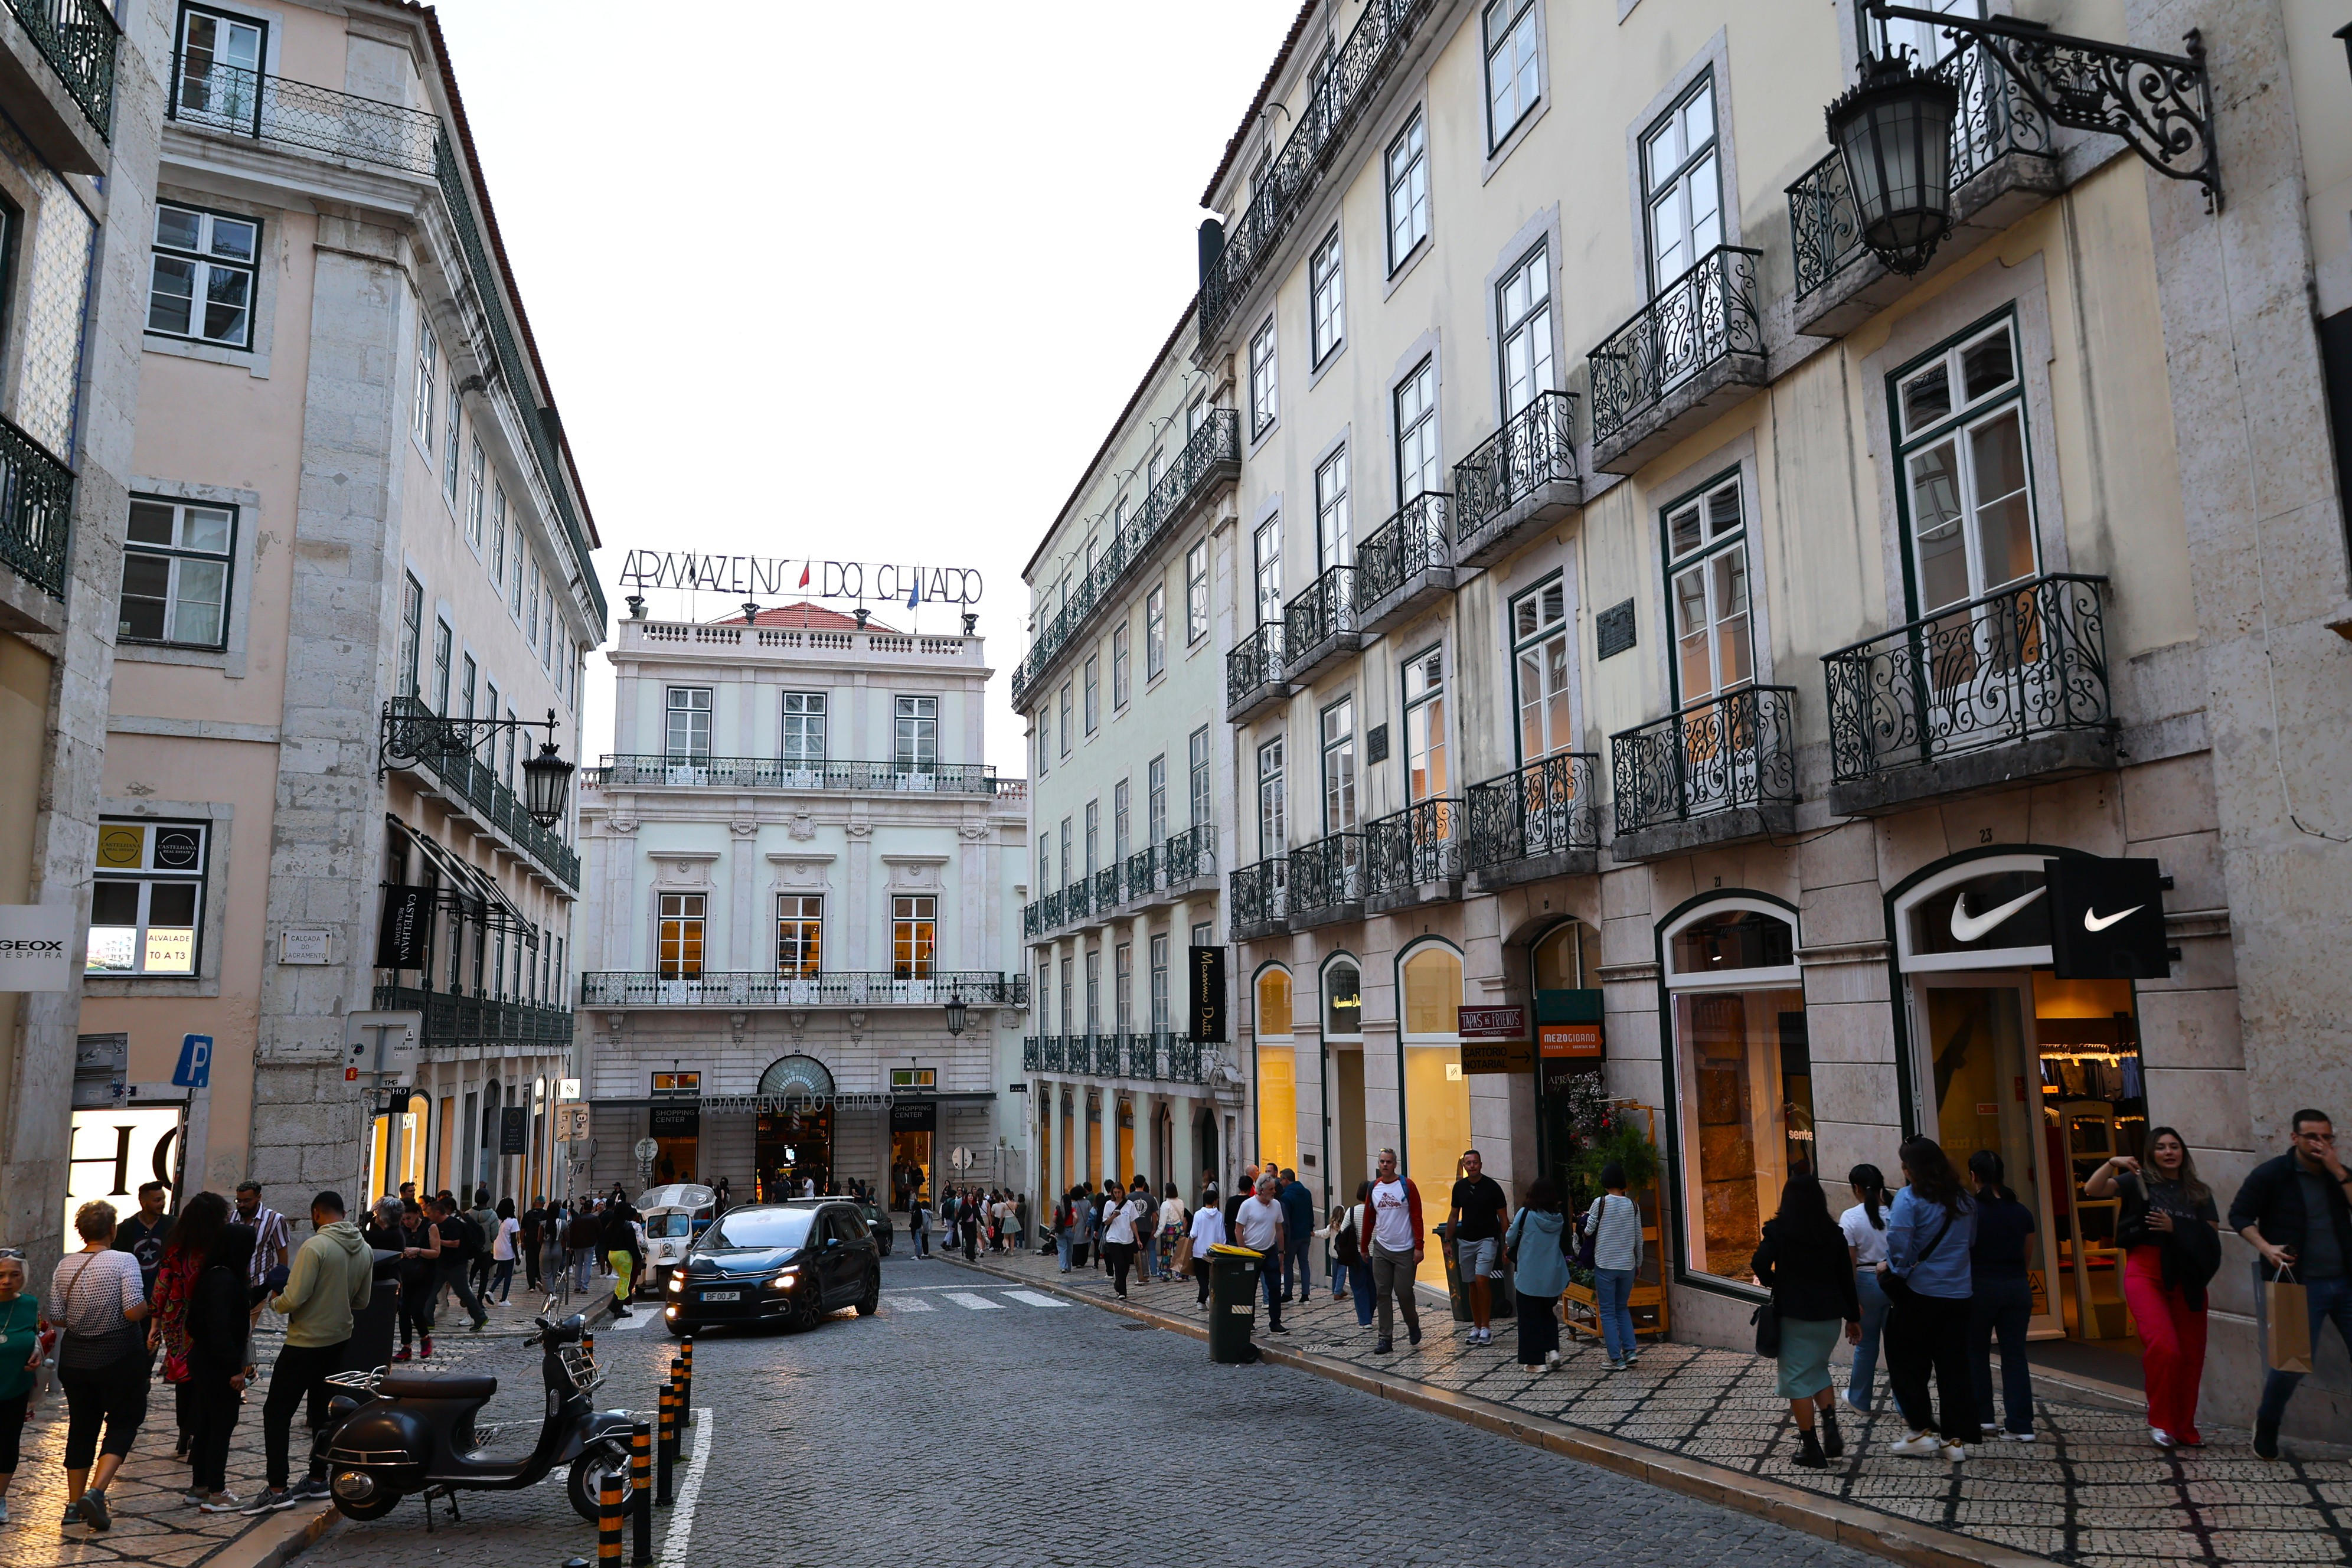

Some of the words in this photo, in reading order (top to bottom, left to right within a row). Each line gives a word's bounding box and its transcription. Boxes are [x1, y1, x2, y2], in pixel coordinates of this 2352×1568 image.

[619, 549, 790, 594] ARMAZENS
[824, 561, 863, 598] DO
[878, 564, 982, 604] CHIADO
[1979, 828, 1992, 843] 23
[1714, 876, 1721, 887] 21
[396, 907, 404, 923] REAL
[394, 923, 402, 946] ESTATE
[400, 894, 417, 961] CASTELHANA
[0, 940, 63, 951] GEOX
[1201, 951, 1214, 1002] Massimo
[1332, 994, 1353, 1009] Massimo
[1201, 1005, 1214, 1037] Dutti
[1461, 1013, 1482, 1028] TAPAS
[1544, 1033, 1595, 1043] MEZZOGIORNO
[1464, 1045, 1507, 1057] CARTÓRIO
[187, 1041, 208, 1081] P
[1464, 1059, 1508, 1070] NOTARIAL
[698, 1093, 791, 1115] ARMAZENS
[801, 1092, 826, 1112] DO
[833, 1092, 894, 1112] CHIADO
[1789, 1129, 1814, 1141] sente
